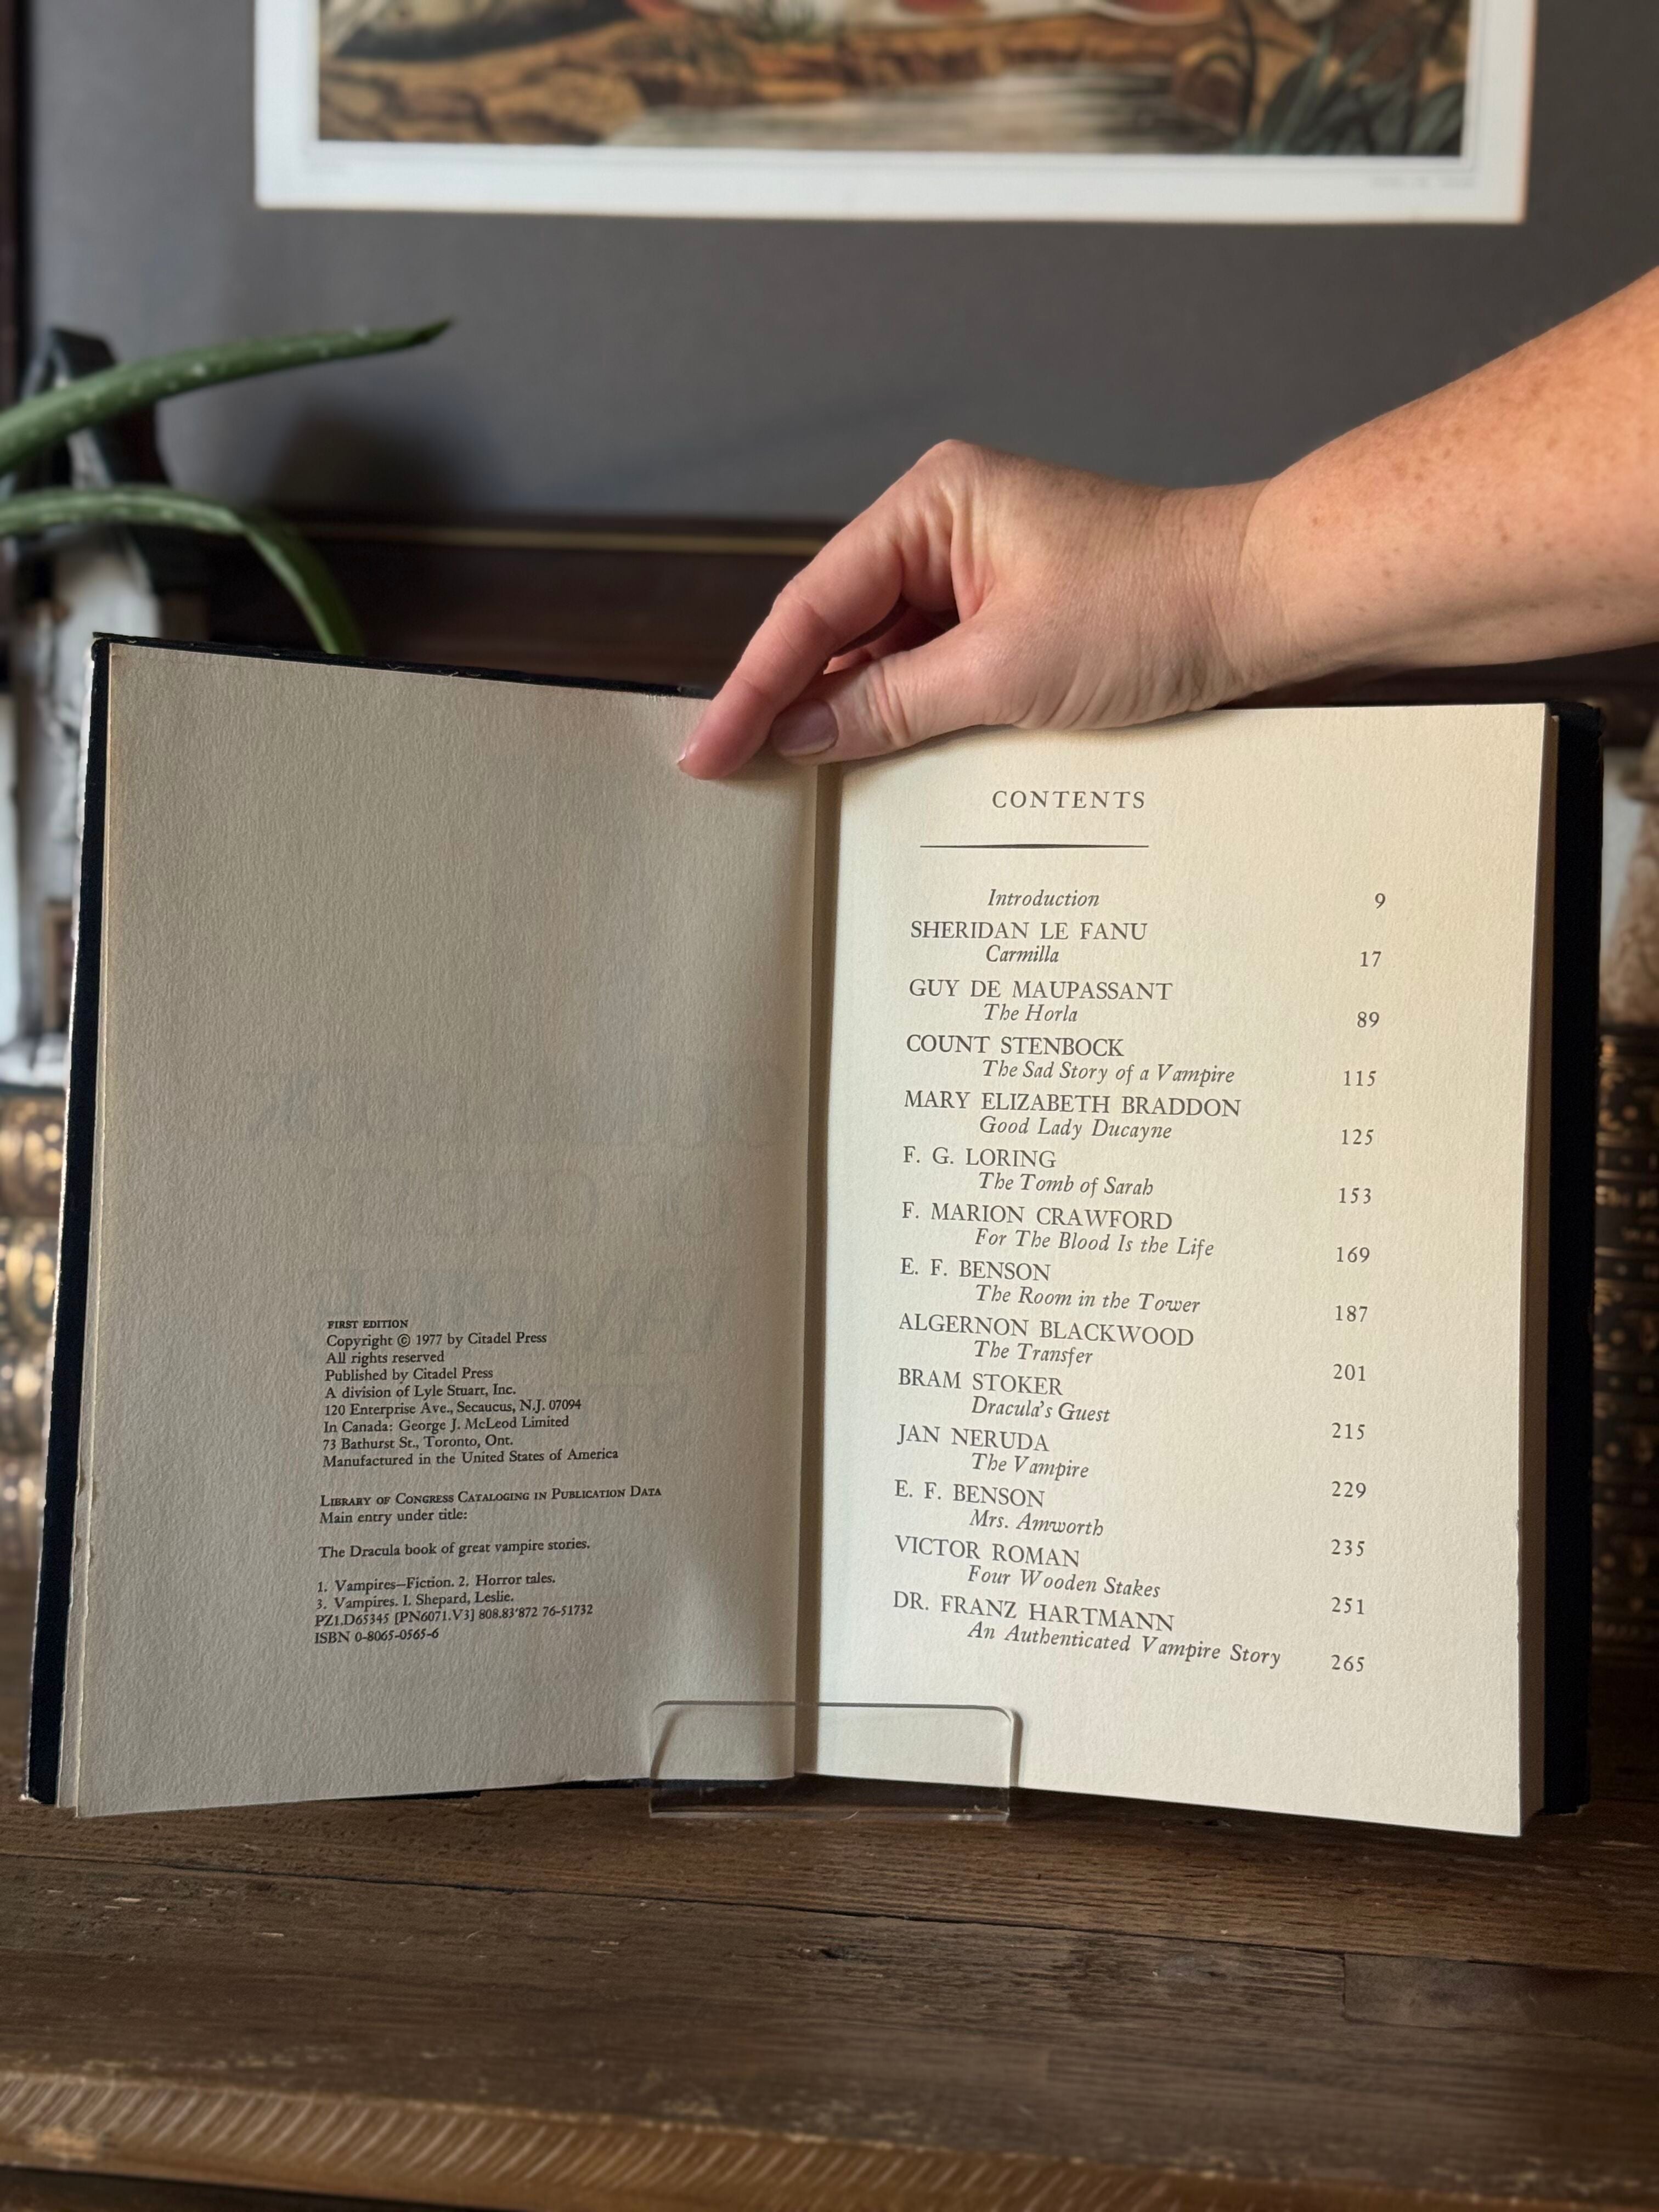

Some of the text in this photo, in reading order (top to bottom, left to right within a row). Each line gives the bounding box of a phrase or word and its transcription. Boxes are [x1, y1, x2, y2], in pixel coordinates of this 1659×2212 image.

[992, 791, 1144, 809] CONTENTS
[988, 889, 1386, 909] Introduction 9
[911, 921, 1147, 940] SHERIDAN LE FANU
[986, 944, 1381, 967] Carmilla 17
[910, 979, 1173, 1000] GUY DE MAUPASSANT
[984, 1003, 1379, 1028] The Horla 89
[907, 1034, 1124, 1056] COUNT STENBOCK
[983, 1060, 1376, 1087] The Sad Story of a Vampire 115
[905, 1090, 1241, 1116] MARY ELIZABETH BRADDON
[980, 1115, 1374, 1146] Good Lady Ducayne 125
[904, 1146, 1056, 1168] F. G. LORING
[979, 1172, 1371, 1204] The Tomb of Sarah 153
[902, 1201, 1172, 1229] F. MARION CRAWFORD
[975, 1228, 1370, 1262] For The Blood Is the Life 169
[900, 1257, 1051, 1280] E. F. BENSON
[976, 1284, 1368, 1322] The Room in the Tower 187
[328, 1319, 408, 1329] FIRST EDITION
[899, 1313, 1194, 1346] ALGERNON BLACKWOOD
[326, 1334, 393, 1351] Copyright
[417, 1334, 442, 1345] 1977
[447, 1333, 464, 1349] by
[468, 1332, 511, 1344] Citadel
[516, 1331, 547, 1344] Press
[325, 1350, 444, 1368] All rights reserved
[974, 1340, 1365, 1381] The Transfer 201
[325, 1367, 493, 1384] Published by Citadel Press
[899, 1368, 1063, 1395] BRAM STOKER
[325, 1383, 516, 1401] A division of Lyle Stuart, Inc.
[325, 1399, 582, 1419] 120 Enterprise Ave., Secaucus, N.J. 07094
[972, 1396, 1365, 1440] Dracula's Guest 215
[324, 1415, 569, 1435] In Canada: George J. McLeod Limited
[323, 1434, 513, 1451] 73 Bathurst St., Toronto, Ont.
[896, 1424, 1049, 1452] JAN NERUDA
[323, 1447, 619, 1468] Manufactured in the United States of America
[972, 1453, 1366, 1498] The Vampire 229
[895, 1480, 1045, 1507] E. F. BENSON
[319, 1508, 467, 1526] Main entry under title:
[969, 1509, 1365, 1556] Mrs. Amworth 235
[318, 1538, 590, 1558] The Dracula book of great vampire stories.
[895, 1535, 1079, 1567] VICTOR ROMAN
[968, 1565, 1364, 1615] Four Wooden Stakes 251
[894, 1591, 1174, 1631] DR. FRANZ HARTMANN
[314, 1628, 439, 1644] ISBN 0-8065-0565-6
[967, 1621, 1364, 1672] An Authenticated Vampire Story 265
